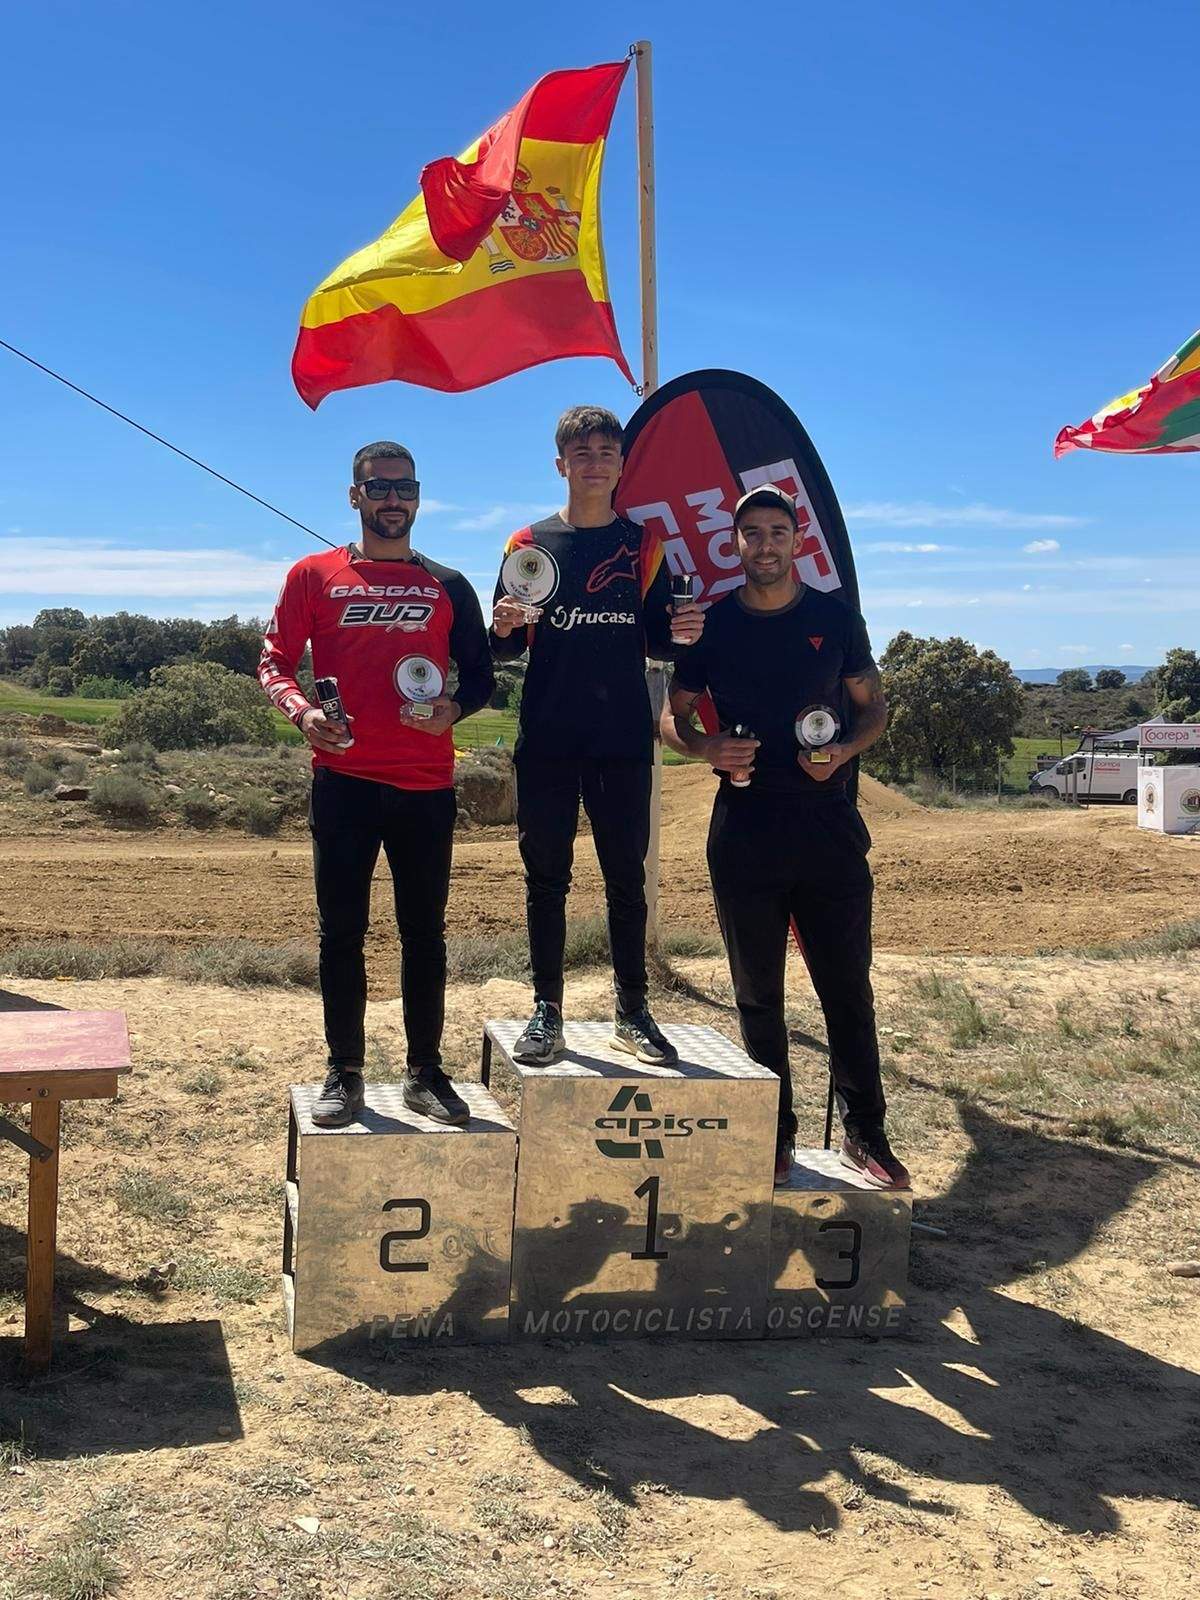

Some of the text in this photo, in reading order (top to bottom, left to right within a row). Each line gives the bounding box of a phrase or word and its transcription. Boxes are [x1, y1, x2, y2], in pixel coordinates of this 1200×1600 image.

[330, 585, 440, 599] GASGAS
[568, 607, 636, 631] frucasa
[1145, 728, 1189, 744] Coorepa
[595, 1114, 728, 1137] apisa
[631, 1176, 668, 1260] 1
[380, 1198, 431, 1273] 2
[815, 1221, 863, 1290] 3
[369, 1304, 902, 1339] PEÑA MOTOCICLISTA OSCENSE
